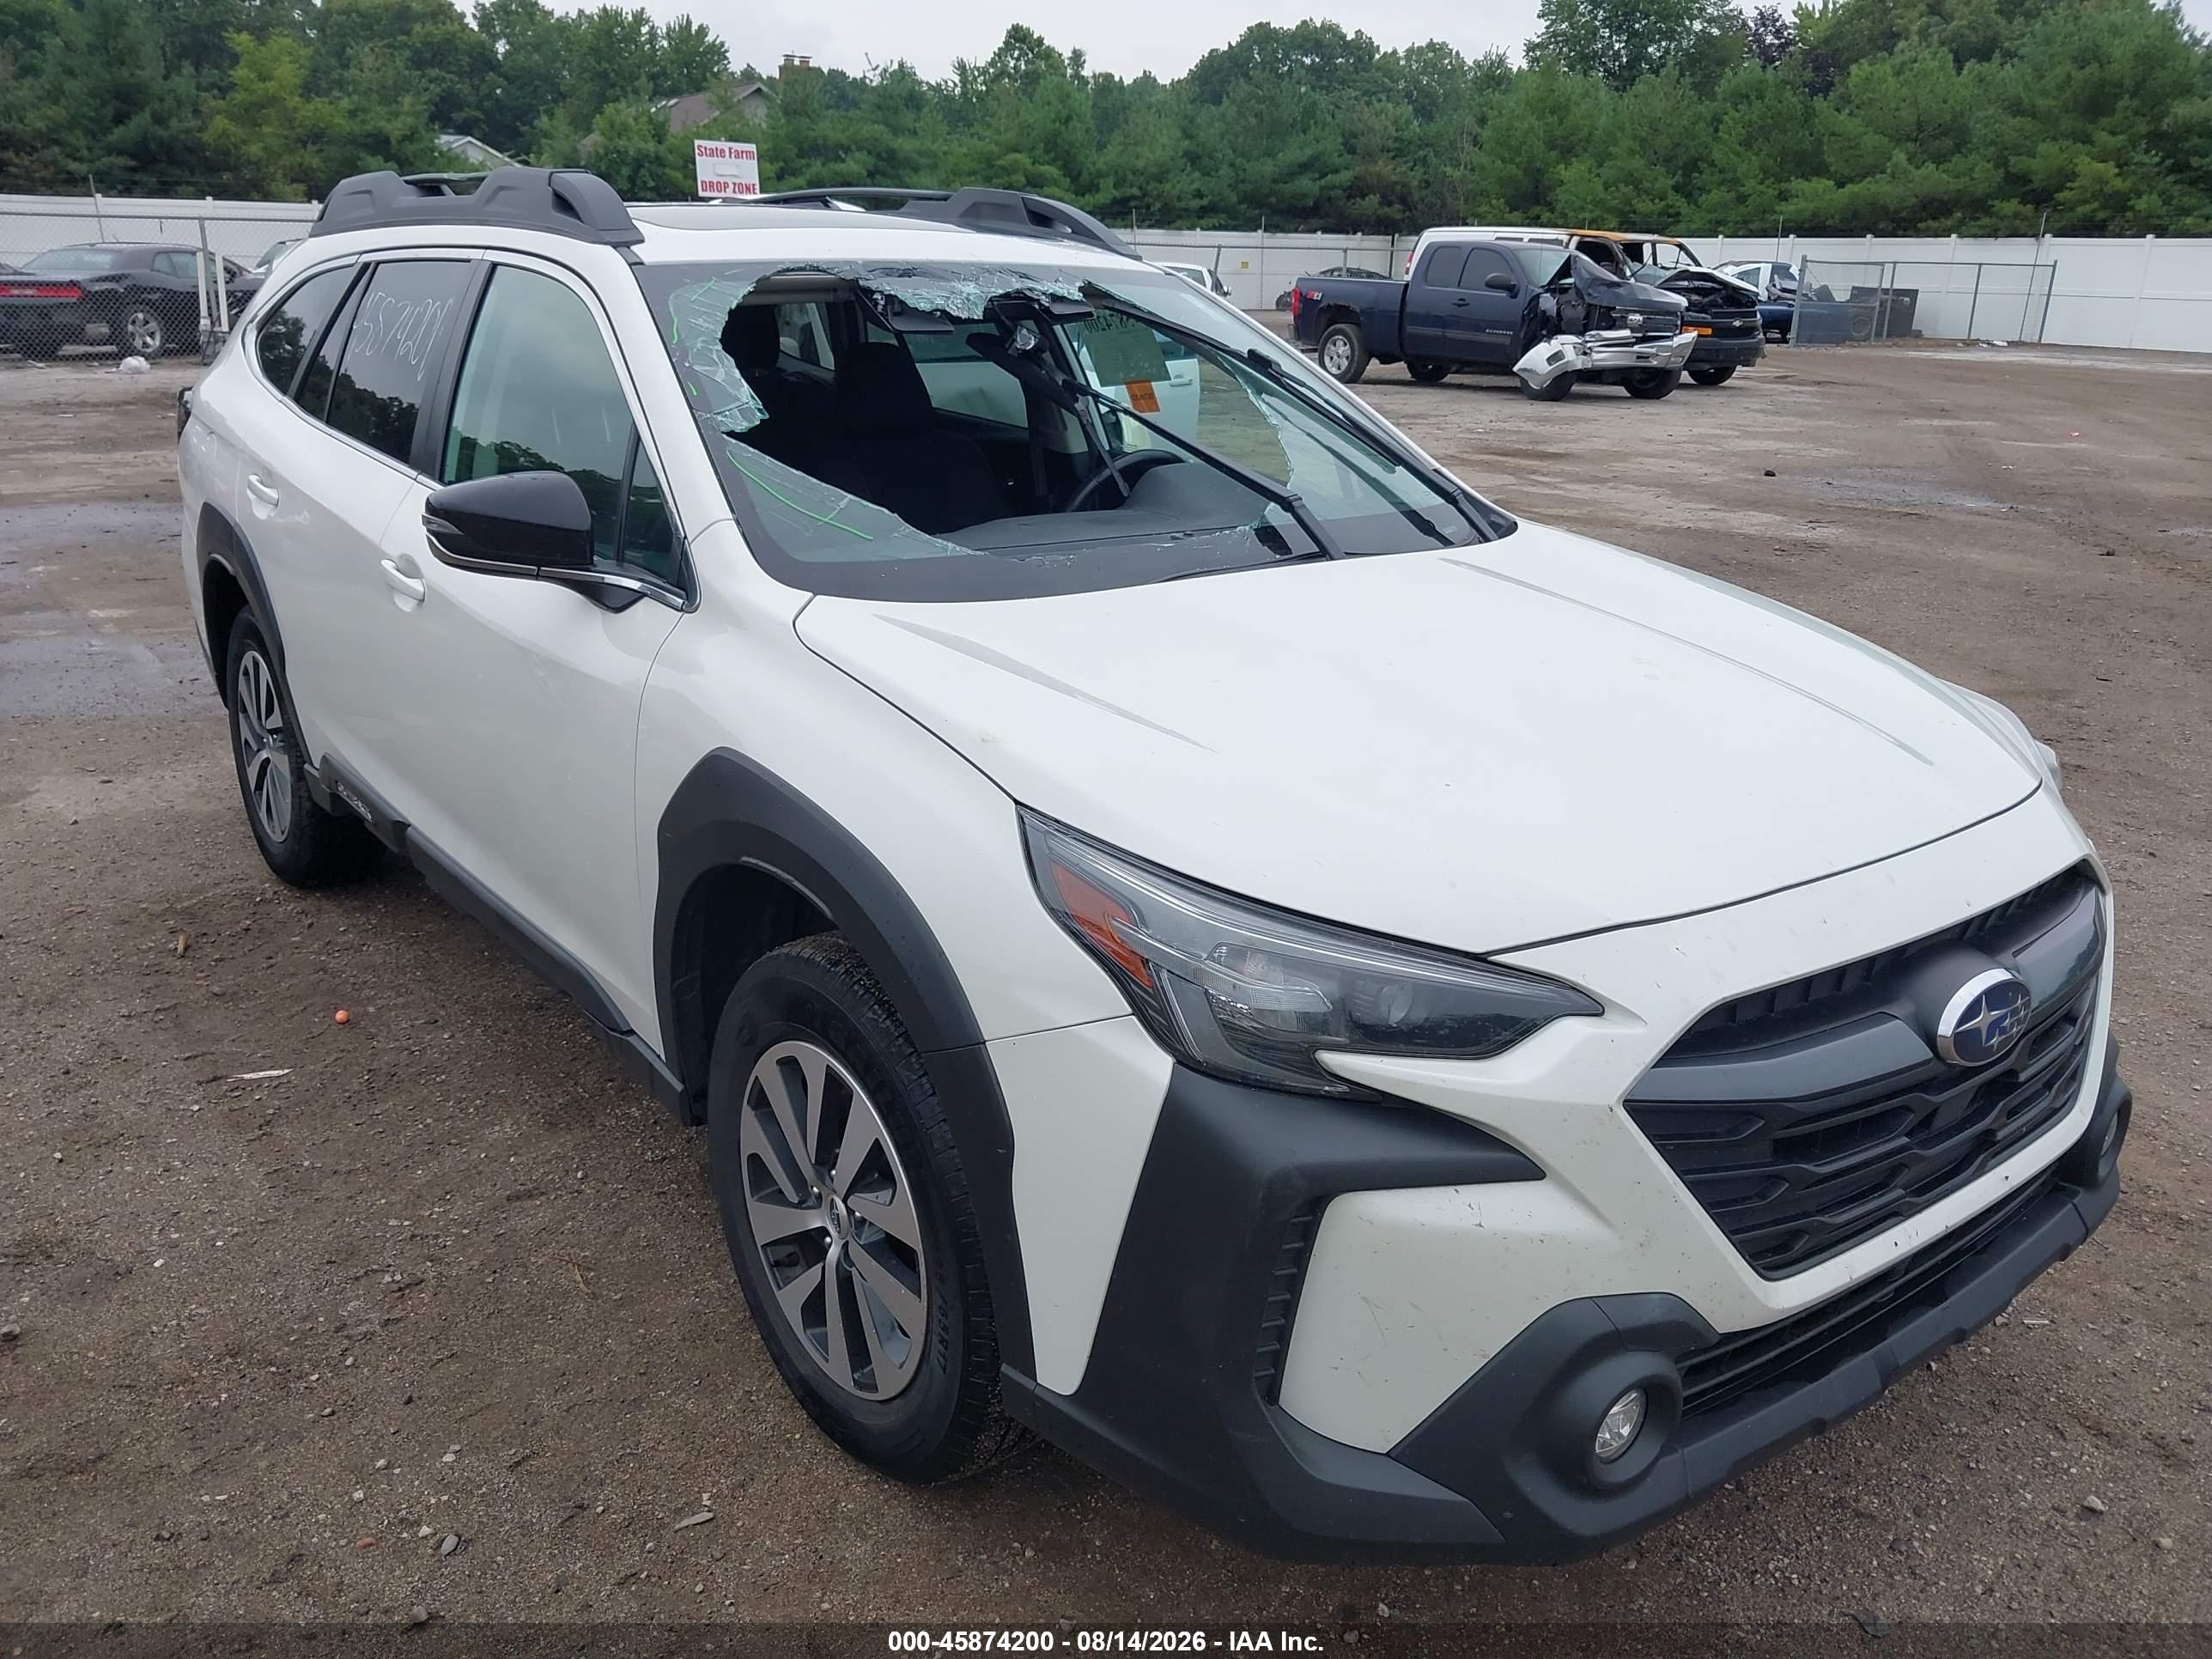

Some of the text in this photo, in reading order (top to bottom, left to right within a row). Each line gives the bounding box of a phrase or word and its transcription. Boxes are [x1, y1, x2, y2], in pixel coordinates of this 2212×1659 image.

[696, 144, 756, 161] State Farm
[701, 179, 757, 195] DROP ZONE
